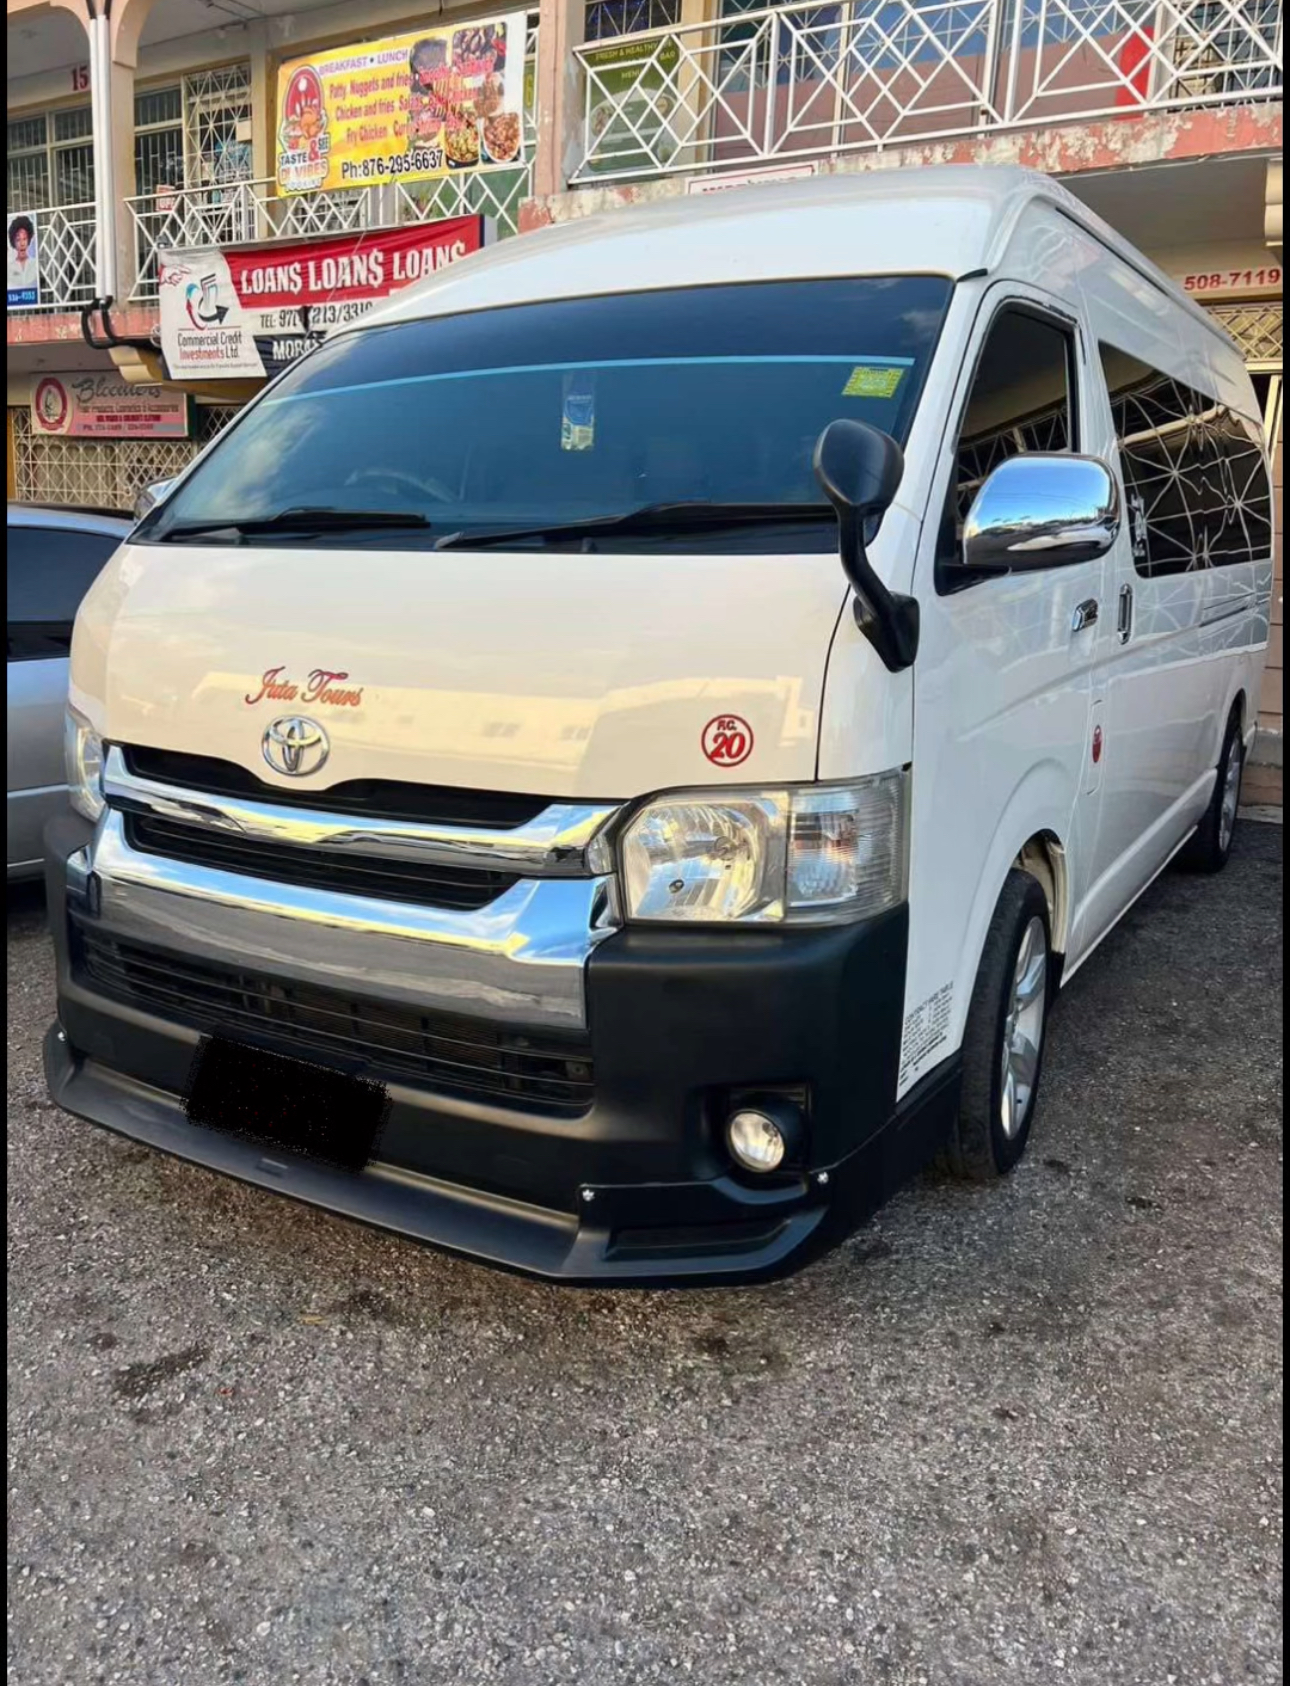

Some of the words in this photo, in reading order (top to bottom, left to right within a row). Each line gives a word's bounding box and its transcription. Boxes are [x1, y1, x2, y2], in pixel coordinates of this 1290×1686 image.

[319, 56, 368, 75] BREAKFAST
[377, 50, 408, 65] LUNCH
[72, 65, 88, 91] 15
[350, 77, 379, 97] Nuggets
[380, 74, 394, 89] and
[336, 103, 363, 121] Chicken
[364, 100, 377, 117] and
[379, 97, 394, 114] fries
[359, 124, 388, 141] Chicken
[281, 151, 308, 167] TASTE
[1184, 268, 1280, 291] 508-7119
[177, 332, 219, 347] Commercial
[220, 331, 242, 345] Credit
[179, 347, 224, 360] Investments
[245, 666, 298, 705] Juta
[301, 669, 364, 707] Tours
[711, 732, 746, 759] 20
